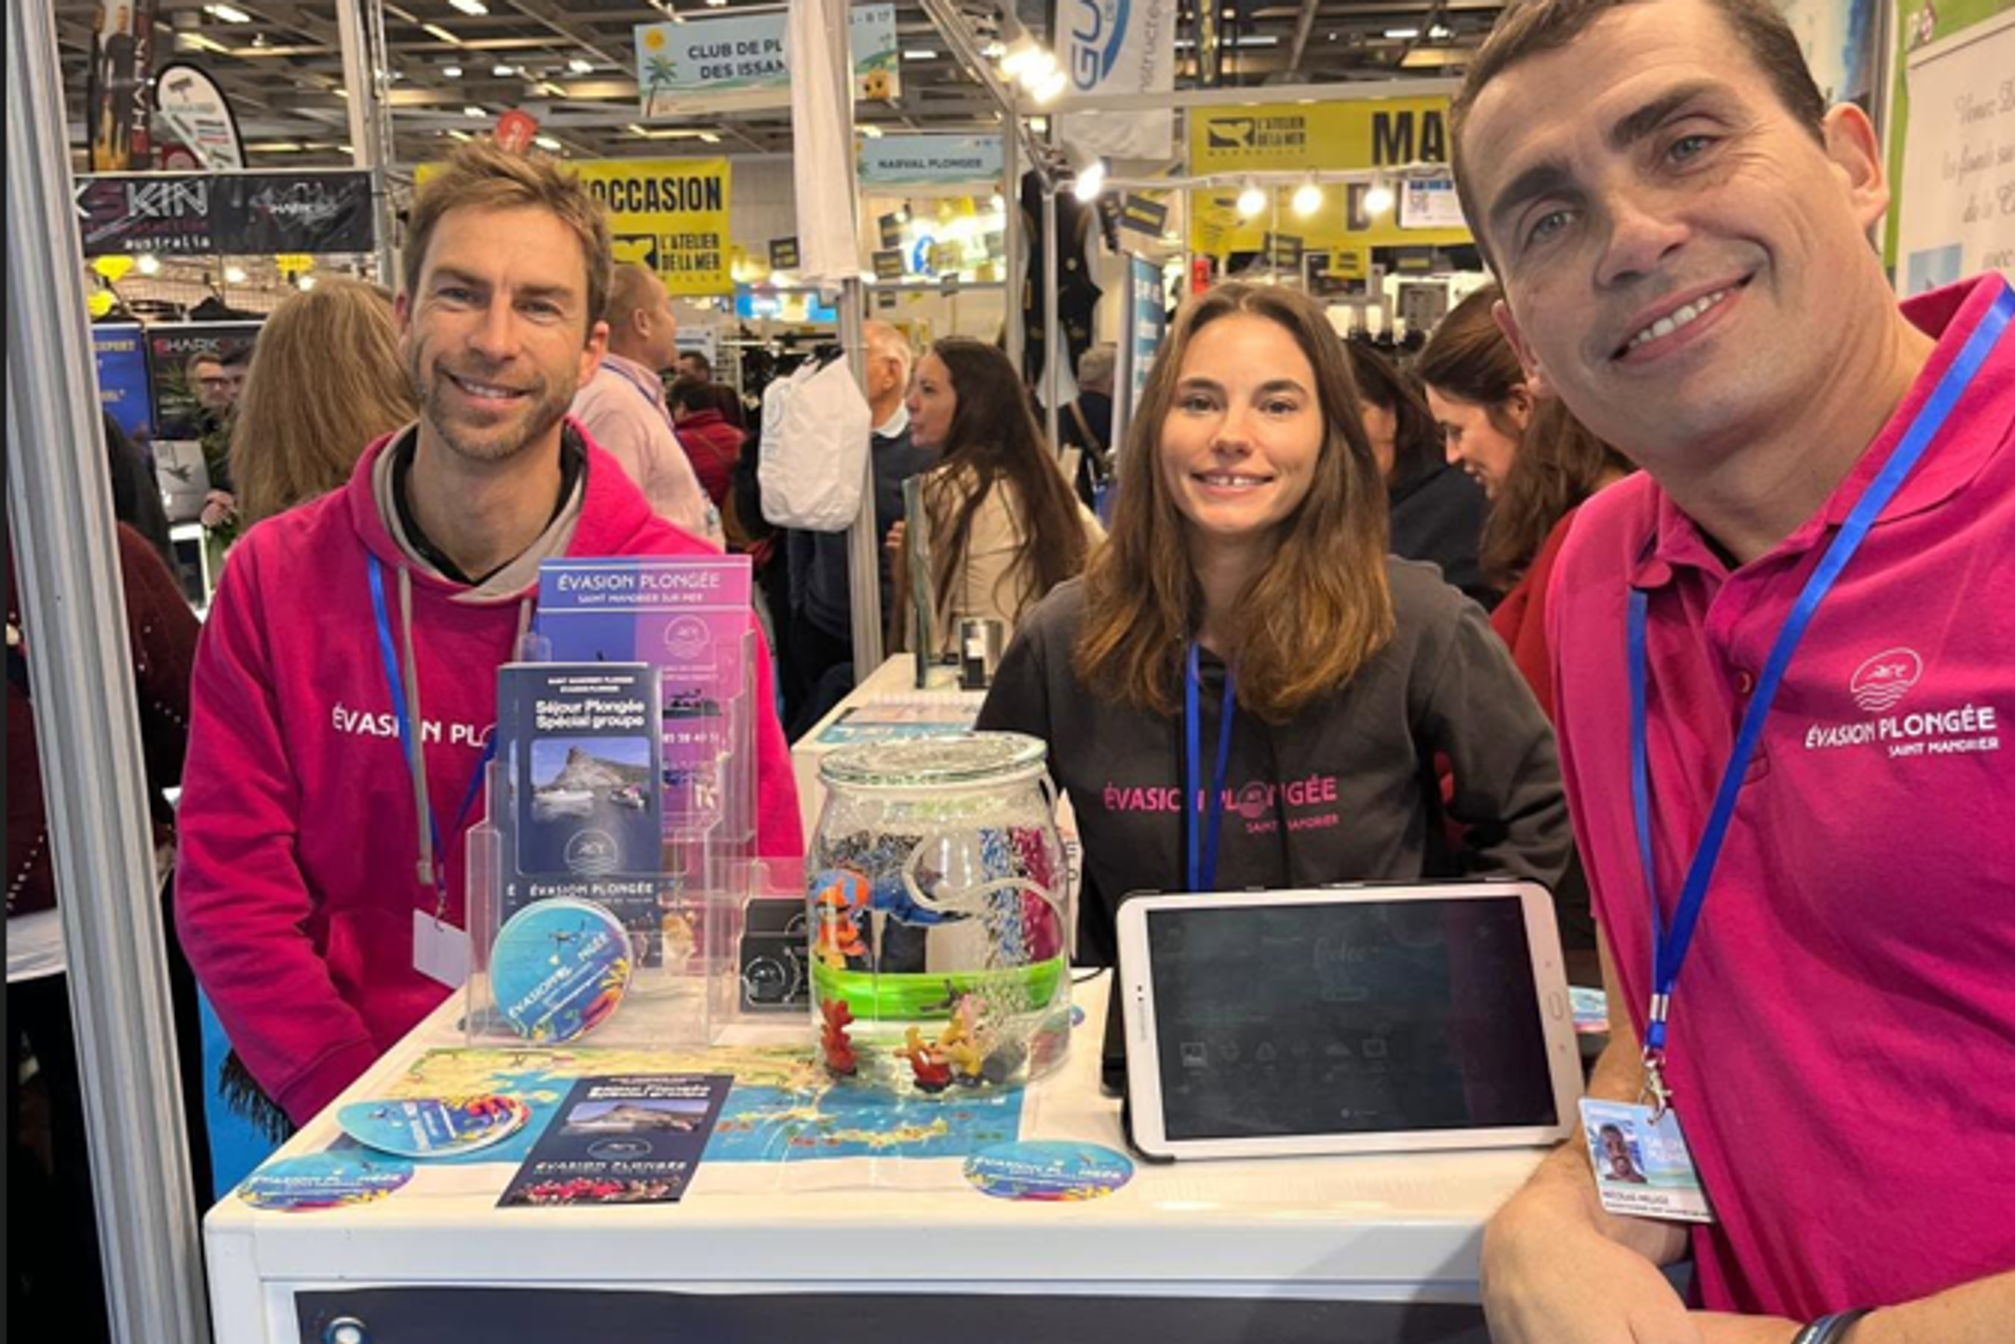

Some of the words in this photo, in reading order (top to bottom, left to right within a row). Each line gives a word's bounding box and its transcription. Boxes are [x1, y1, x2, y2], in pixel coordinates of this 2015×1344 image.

[688, 41, 732, 60] CLUB
[736, 39, 759, 56] DE
[701, 64, 734, 80] DES
[557, 573, 635, 591] ÉVASION
[640, 572, 720, 589] PLONGÉE
[535, 700, 582, 716] Séjour
[584, 699, 645, 716] Plongée
[332, 702, 442, 743] ÉVASIN
[451, 722, 497, 748] PL
[535, 715, 591, 731] Spécial
[592, 714, 645, 730] groupe
[1805, 721, 1875, 749] ÉVASION
[1879, 703, 1996, 741] PLONGÉE
[1888, 742, 1925, 759] SAINT
[1927, 736, 2000, 754] MANDRIER
[591, 882, 654, 895] PLONGÉE
